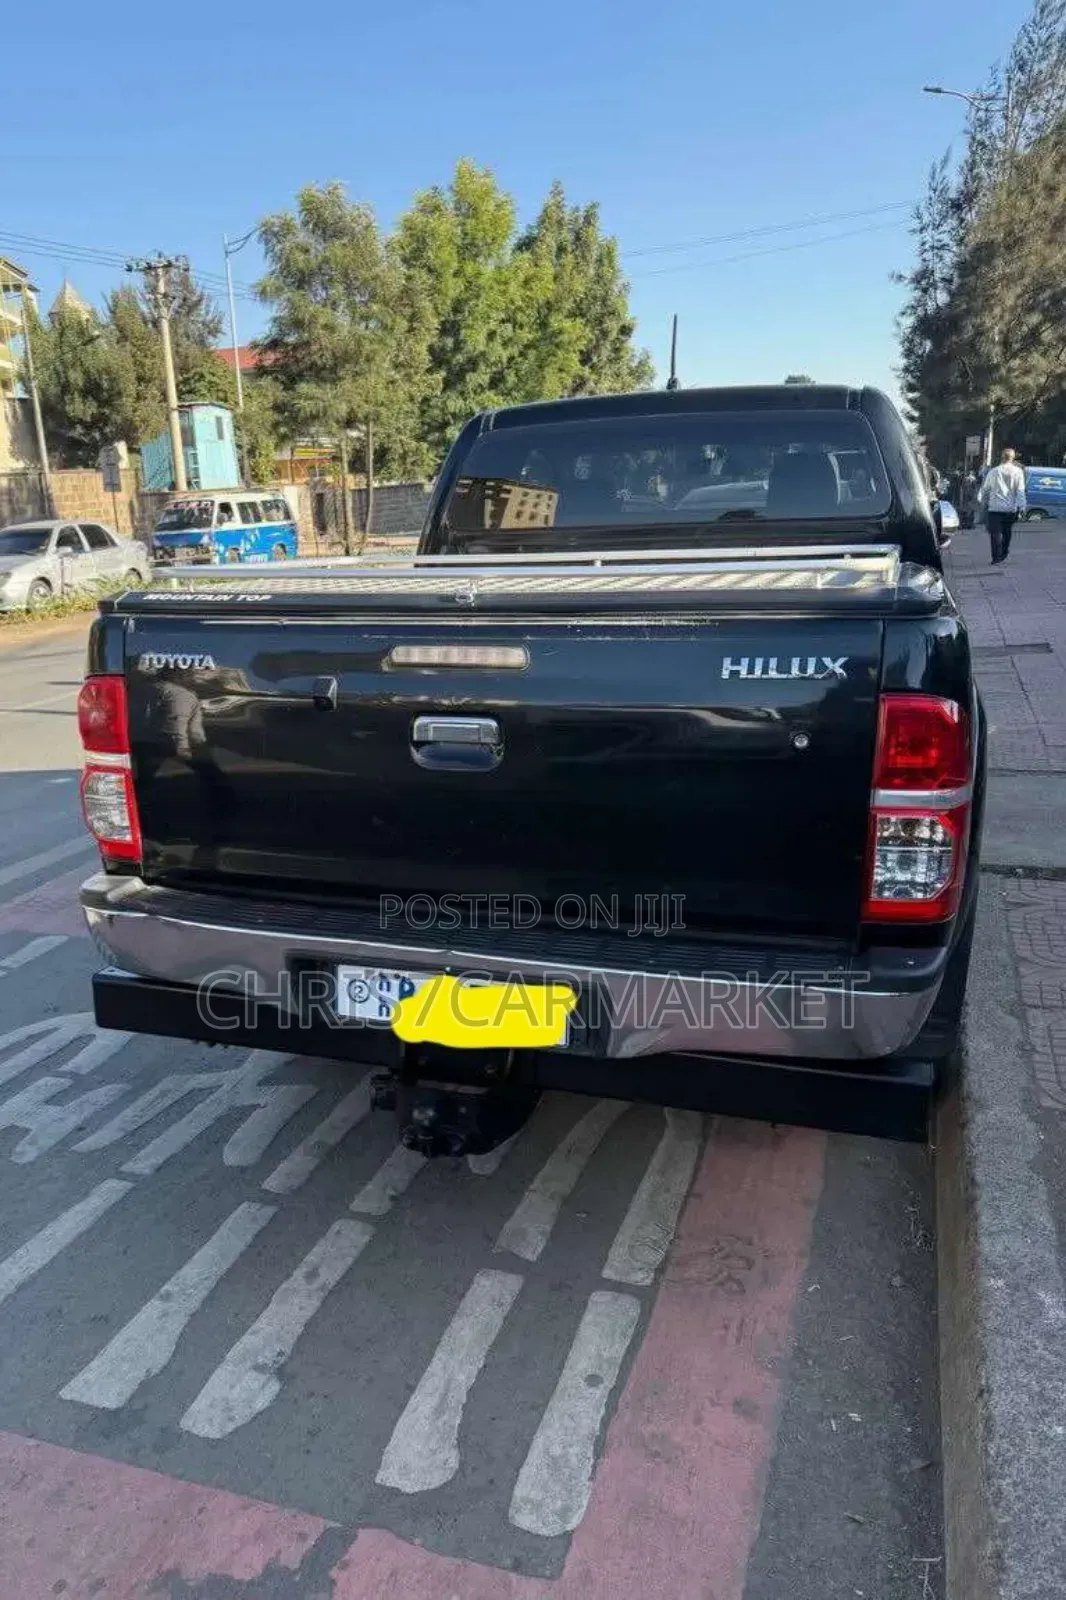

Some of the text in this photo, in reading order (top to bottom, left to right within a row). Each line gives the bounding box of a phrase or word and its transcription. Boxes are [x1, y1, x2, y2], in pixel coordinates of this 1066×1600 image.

[236, 594, 272, 602] TOP
[144, 653, 216, 670] TOYOTA
[720, 656, 849, 679] HILUX
